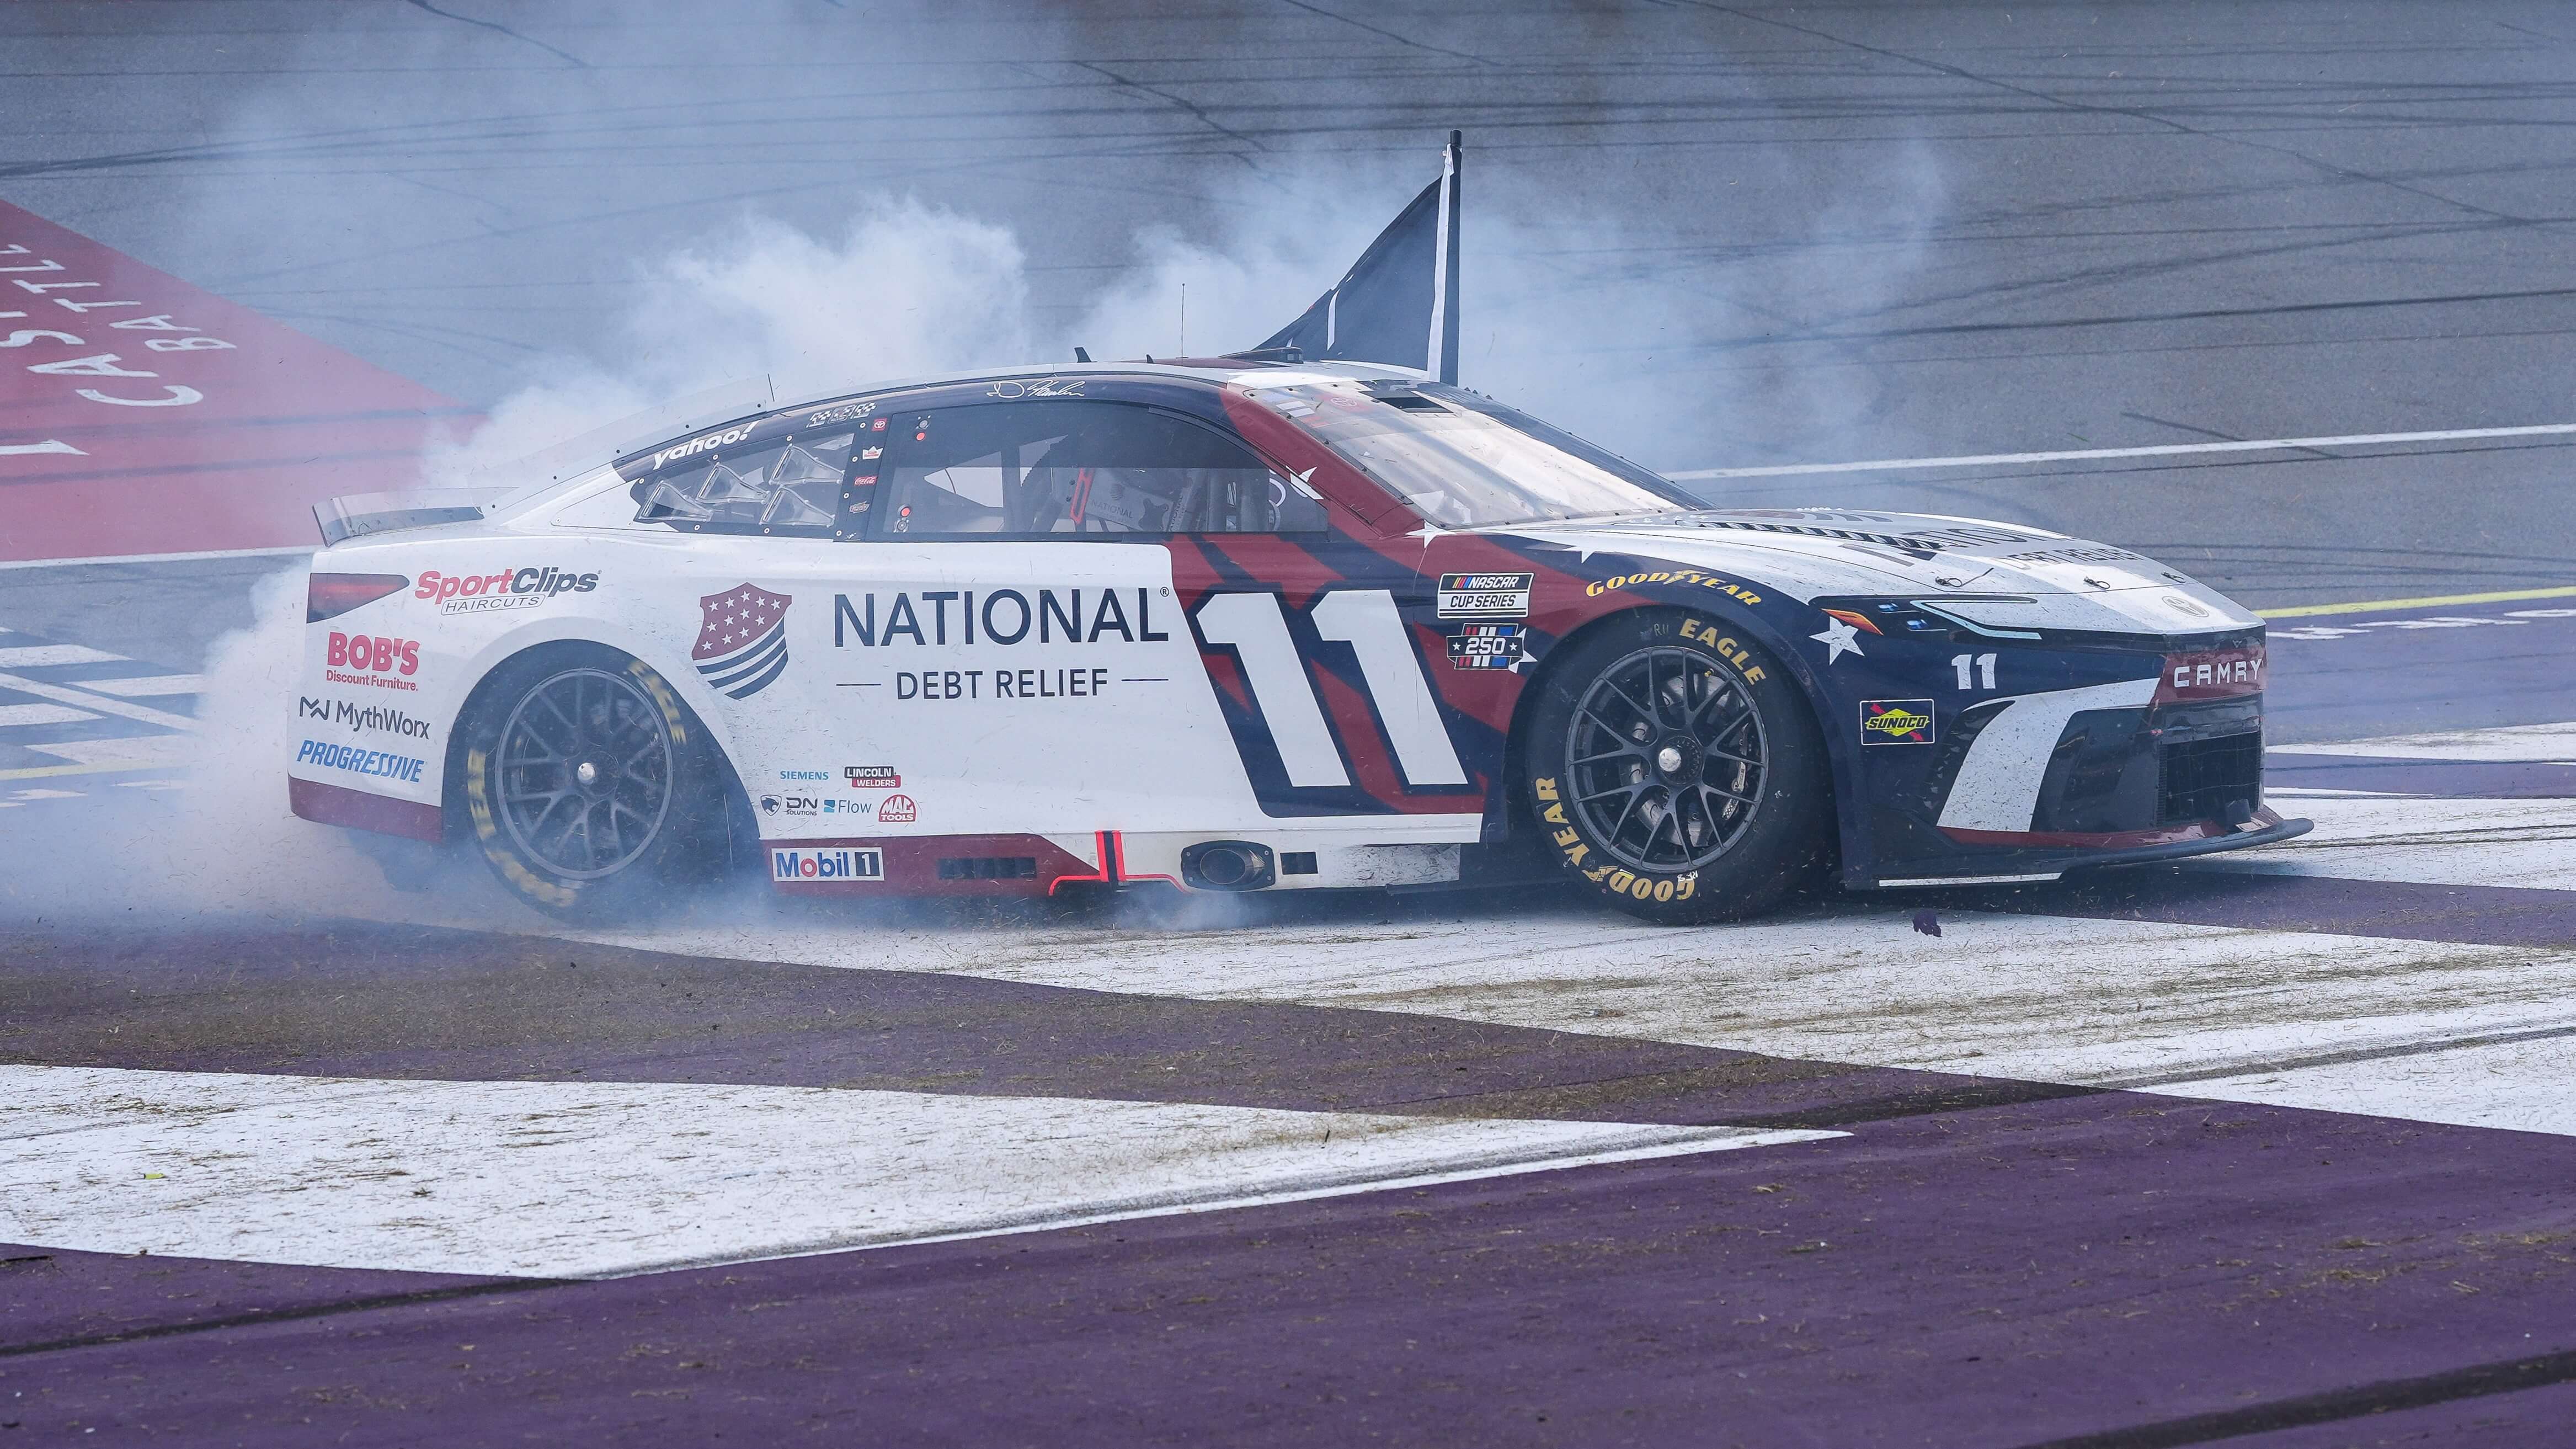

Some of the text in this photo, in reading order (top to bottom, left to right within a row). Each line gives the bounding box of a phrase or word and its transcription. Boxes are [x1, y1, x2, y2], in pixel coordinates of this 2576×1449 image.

[653, 422, 759, 470] yahoo!
[1091, 499, 1134, 518] NATIONAL
[1469, 576, 1519, 589] NASCAR
[1586, 570, 1762, 606] GOODYEAR
[445, 595, 540, 612] HAIRCUTS
[1450, 595, 1516, 608] CUP SERIES
[327, 632, 420, 676] BOB'S
[1465, 637, 1506, 654] 250
[1679, 618, 1767, 685] EAGLE
[326, 670, 370, 686] Discount
[1951, 653, 1997, 690] 11
[2174, 658, 2263, 688] CAMRY
[897, 668, 1108, 700] DEBT RELIEF
[1196, 589, 1468, 787] 11
[336, 702, 430, 740] MythWorx
[1869, 717, 1927, 729] SUNOCO
[297, 740, 425, 783] PROGRESSIVE
[780, 771, 829, 780] SIEMENS
[847, 768, 892, 777] LINCOLN
[856, 779, 896, 787] WELDERS
[787, 797, 818, 809] DN
[839, 800, 872, 813] Flow
[883, 796, 914, 814] MAC
[1534, 777, 1695, 902] GOODYEAR
[775, 852, 850, 878] Mobil
